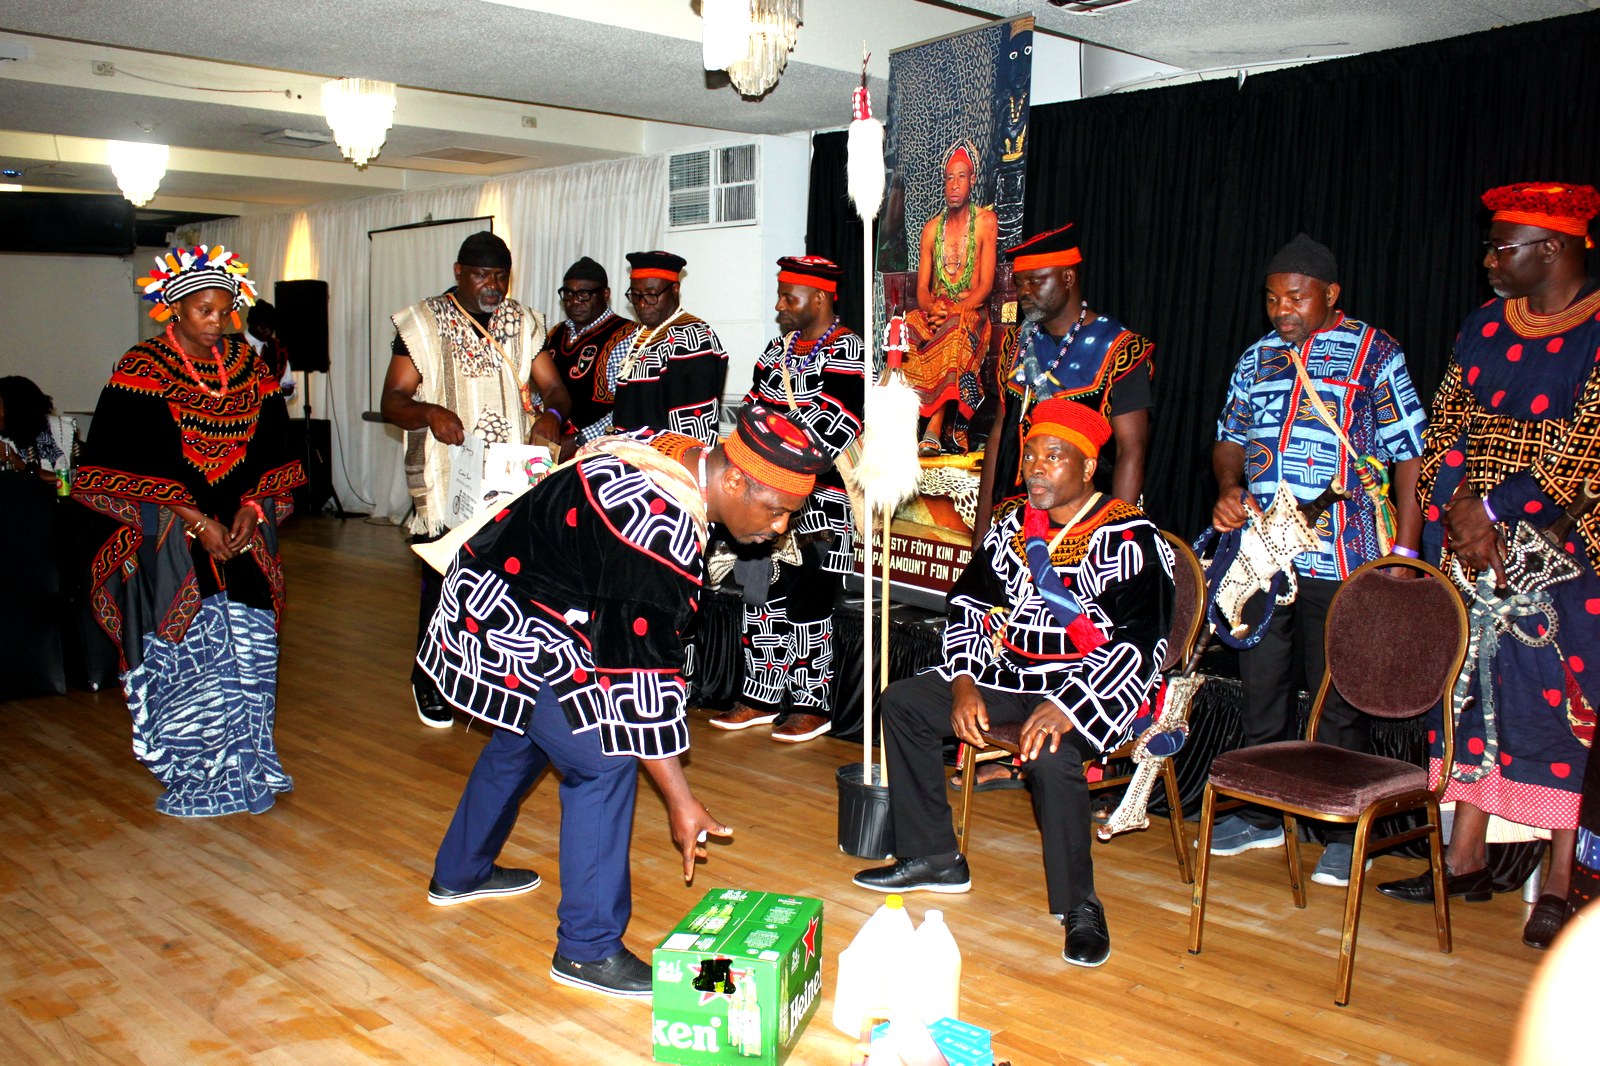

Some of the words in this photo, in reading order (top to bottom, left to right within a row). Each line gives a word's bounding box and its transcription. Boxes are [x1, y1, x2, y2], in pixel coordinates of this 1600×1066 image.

[854, 530, 865, 544] HI
[872, 534, 908, 552] ASTY
[936, 545, 954, 562] KINI
[854, 547, 865, 562] TH
[872, 551, 927, 576] PAAMOUNT
[930, 563, 949, 581] FON
[652, 1019, 720, 1053] ken
